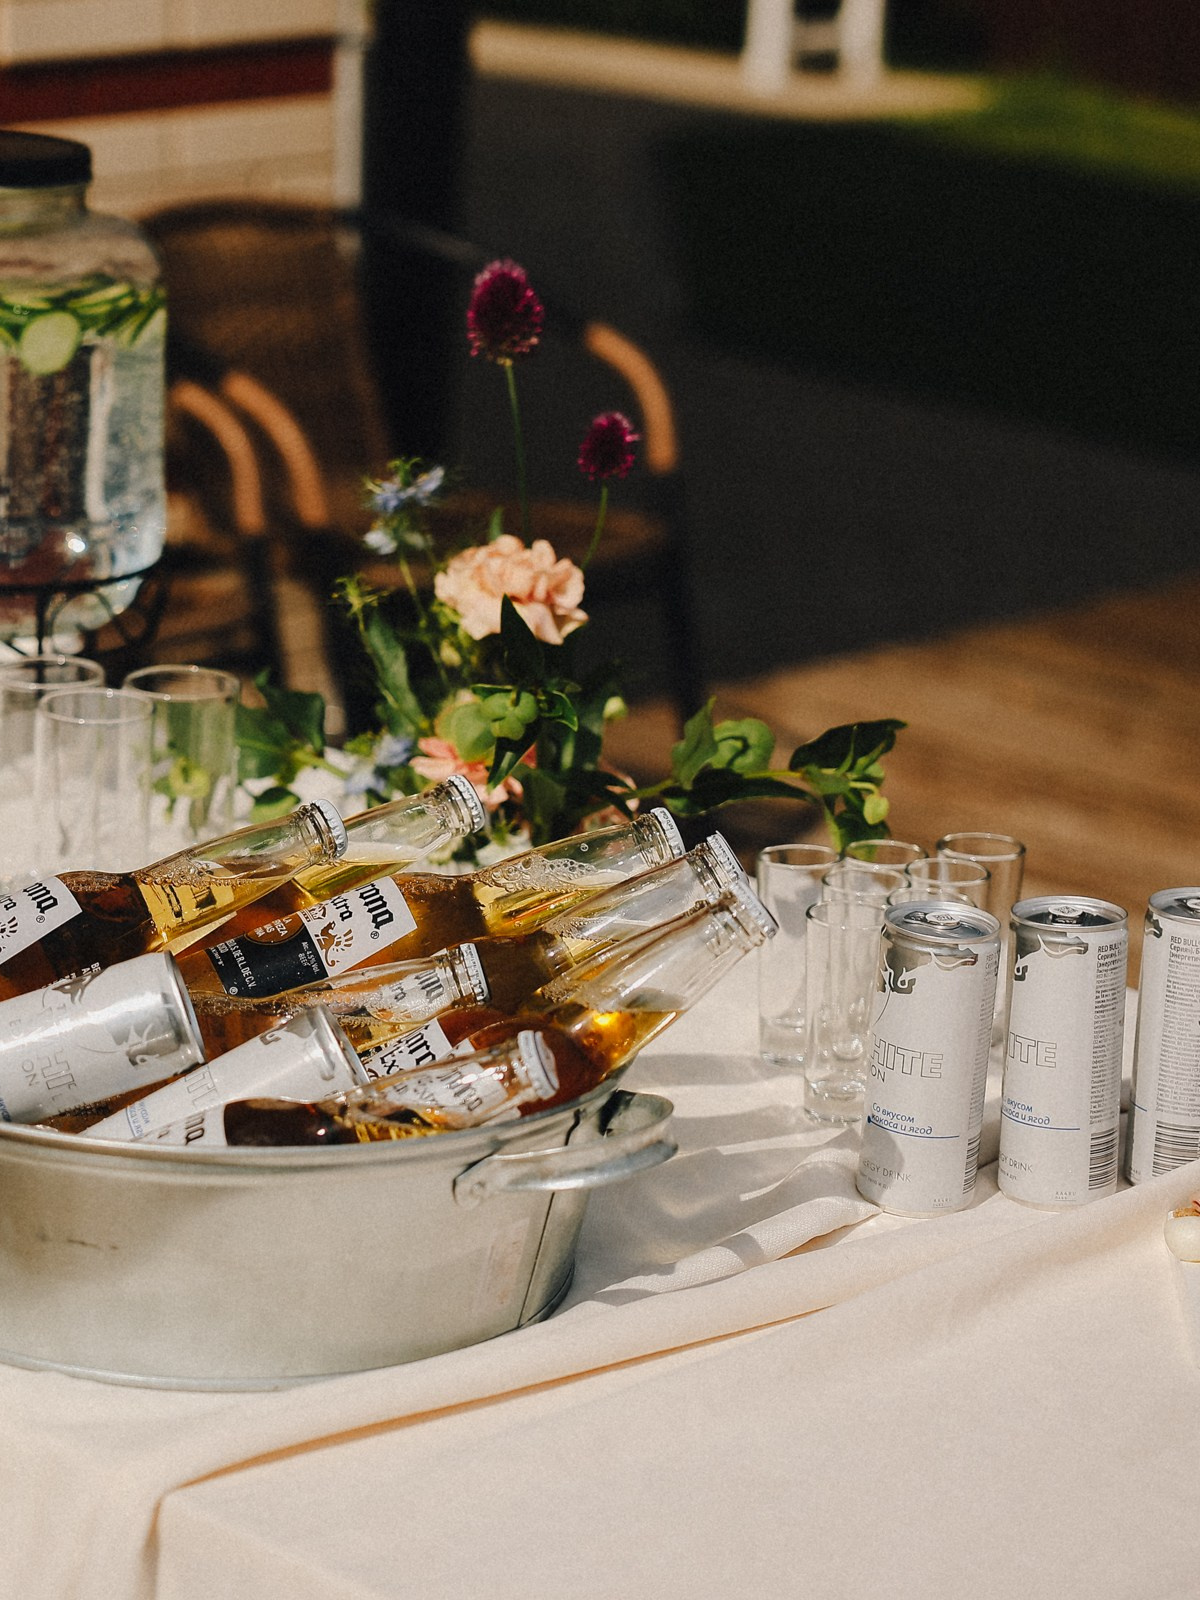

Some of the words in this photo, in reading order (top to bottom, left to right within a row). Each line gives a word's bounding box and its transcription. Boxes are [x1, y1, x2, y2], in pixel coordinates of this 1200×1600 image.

[872, 1102, 881, 1113] Со
[881, 1107, 915, 1124] вкусом
[1020, 1110, 1027, 1121] и
[1028, 1115, 1051, 1126] ягод
[900, 1122, 907, 1132] и
[908, 1125, 933, 1135] ягод
[1008, 1157, 1034, 1174] DRINK
[882, 1167, 912, 1183] DRINK
